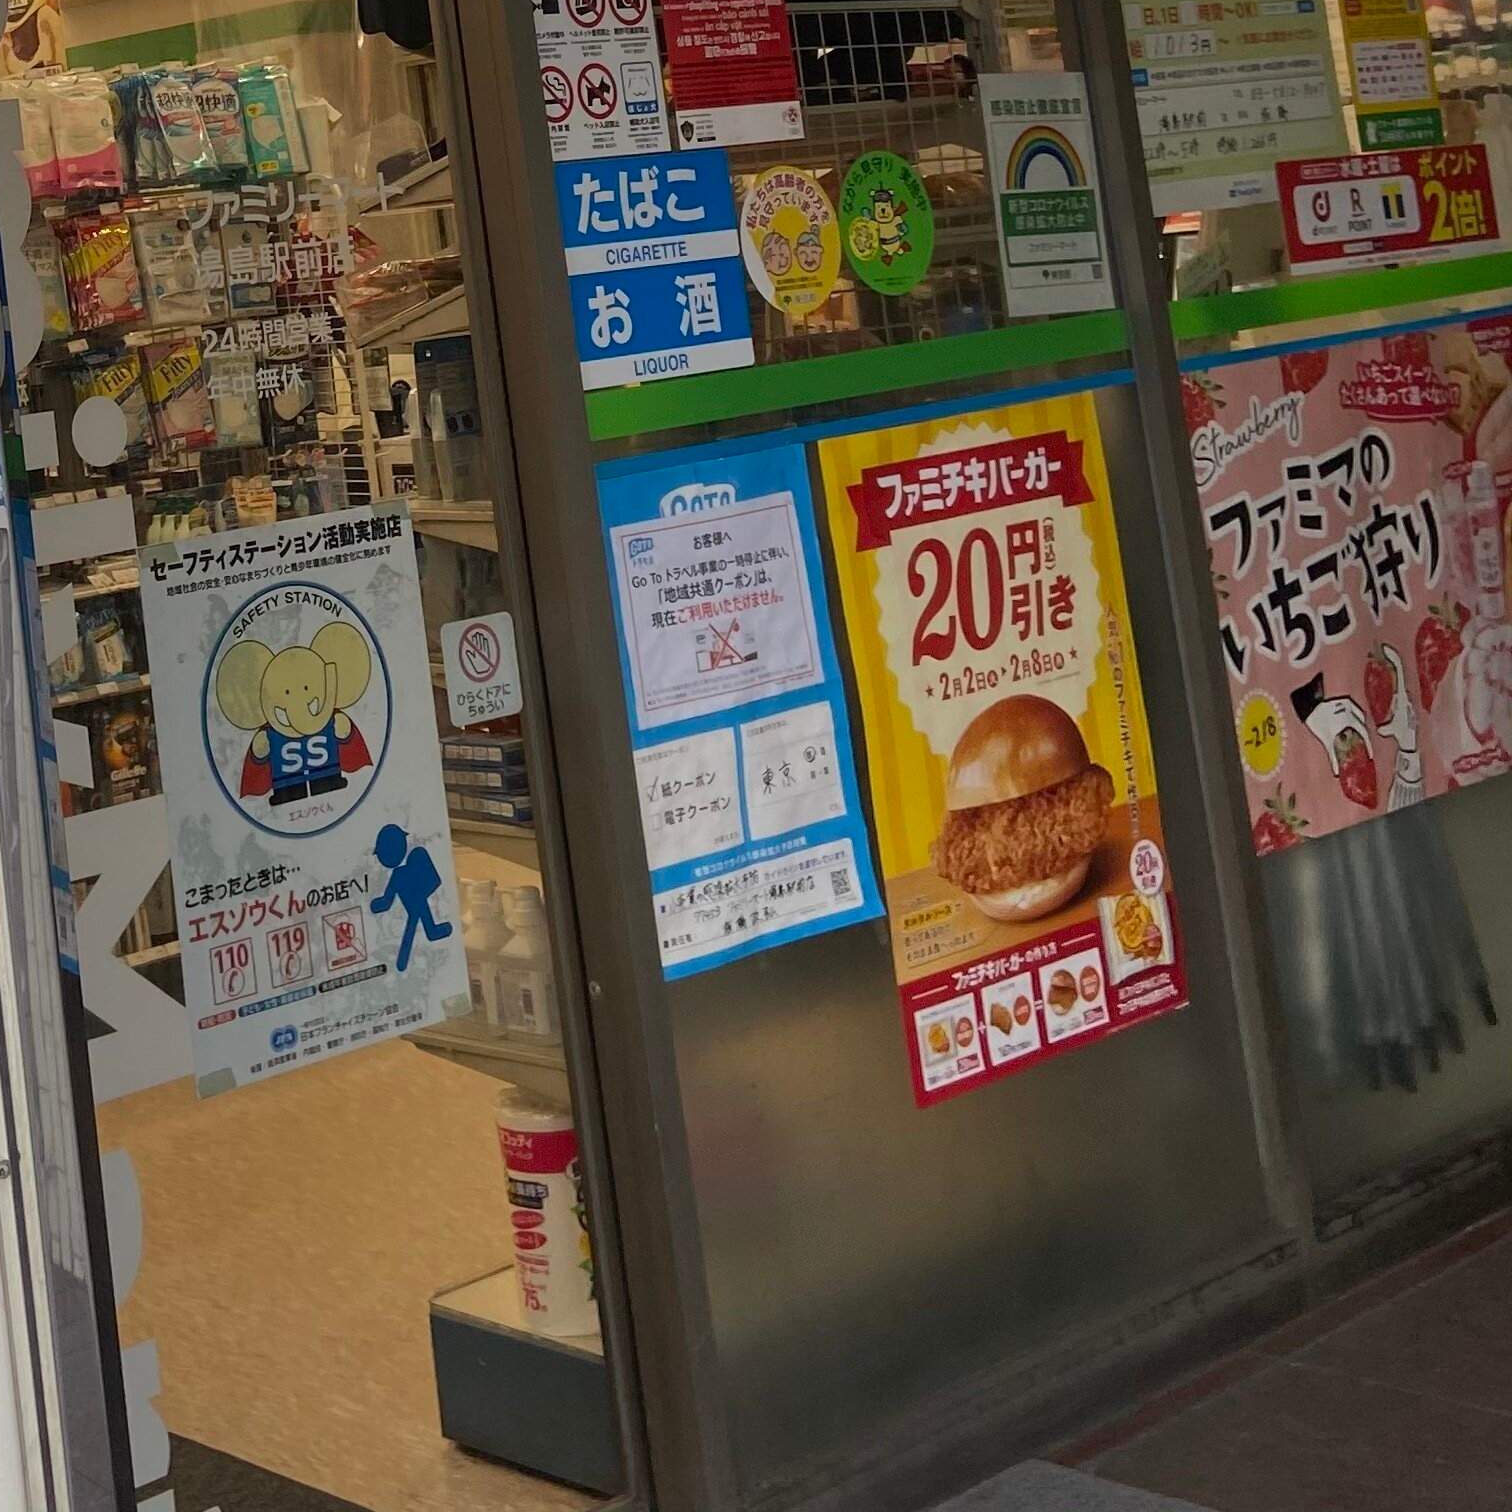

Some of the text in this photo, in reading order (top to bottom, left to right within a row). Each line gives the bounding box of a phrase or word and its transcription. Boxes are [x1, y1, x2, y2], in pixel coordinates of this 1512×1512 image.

[573, 165, 706, 234] たばこ
[605, 240, 688, 266] CIGARETTE
[201, 311, 335, 356] 24時間営業
[102, 360, 136, 393] Fitty
[160, 352, 194, 384] Fitty
[633, 353, 690, 377] LIQUOR
[1192, 390, 1303, 486] Strawberry
[876, 446, 1062, 519] ファミチキバーガー
[1210, 433, 1390, 571] ファミマの
[149, 514, 402, 583] セーフティステーション活動実施店
[692, 531, 733, 551] お客様へ
[631, 574, 647, 589] Go
[650, 571, 663, 584] To
[1221, 496, 1440, 676] いちご狩り
[231, 590, 343, 640] SAFETY STATION
[456, 682, 512, 707] ひらくドアに
[467, 697, 505, 718] ちゅうい
[280, 735, 329, 774] SS
[760, 760, 797, 795] 東京
[663, 796, 732, 827] 電子クーポン
[188, 874, 369, 943] エスゾウくんのお店へ!
[213, 927, 305, 974] 110 119
